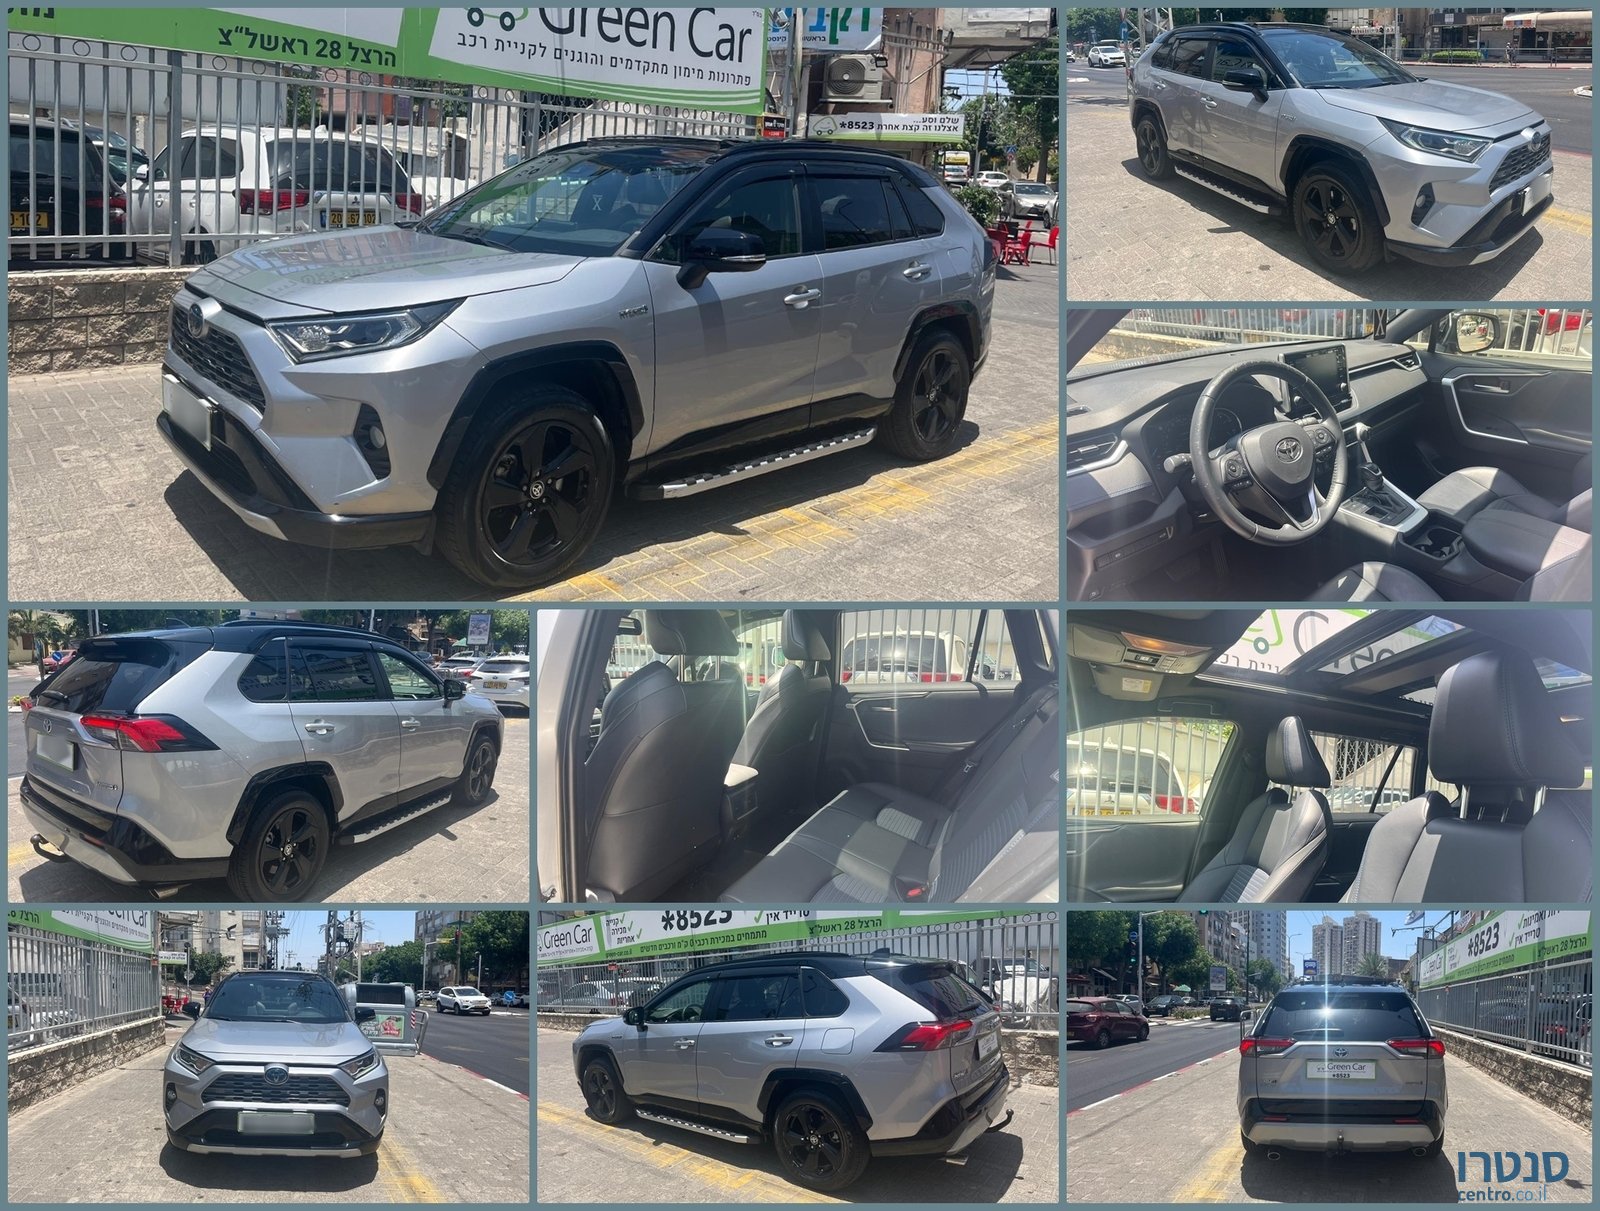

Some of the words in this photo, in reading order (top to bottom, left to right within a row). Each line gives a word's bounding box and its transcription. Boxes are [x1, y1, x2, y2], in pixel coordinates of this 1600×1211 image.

[217, 25, 309, 56] ראשל"צ
[457, 32, 487, 49] רכב
[688, 8, 752, 63] Car
[315, 38, 342, 60] 28
[348, 41, 396, 67] הרצל
[494, 38, 547, 60] לקניית
[553, 47, 603, 66] והוגנים
[609, 56, 668, 75] מתקדמים
[673, 65, 704, 80] מימון
[708, 70, 751, 86] פתרונות
[940, 116, 959, 124] שלם
[877, 123, 900, 131] אחרת
[902, 123, 920, 133] קצת
[922, 123, 932, 132] זה
[934, 123, 959, 132] אצלנו
[844, 920, 856, 930] 28
[857, 918, 882, 930] הרצל
[573, 924, 592, 944] Car
[709, 934, 735, 945] במכירת
[736, 929, 767, 941] מתמחים
[1560, 939, 1569, 952] 28
[1570, 936, 1587, 949] הרצל
[1327, 1062, 1351, 1071] Green
[1352, 1062, 1366, 1071] Car
